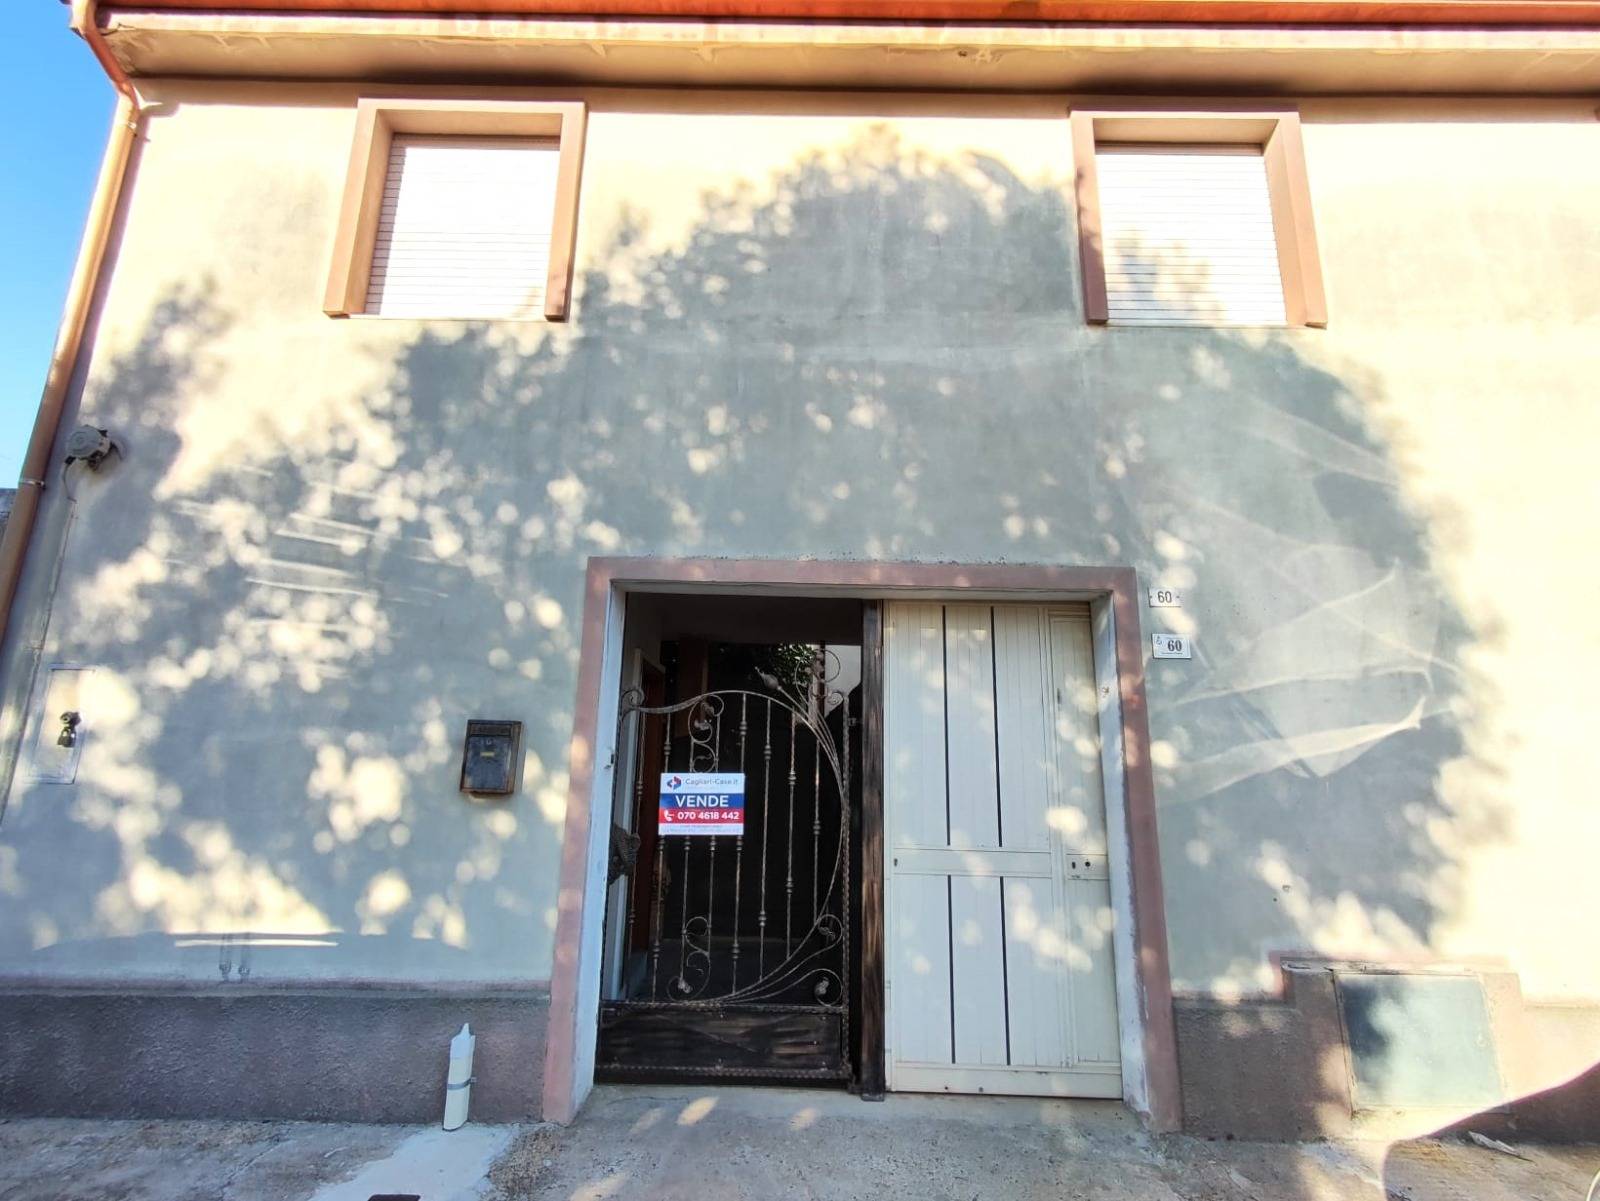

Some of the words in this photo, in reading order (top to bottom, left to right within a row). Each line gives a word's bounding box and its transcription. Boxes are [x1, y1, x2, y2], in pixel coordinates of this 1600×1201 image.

[1157, 590, 1172, 603] 60
[1167, 639, 1182, 652] 60
[675, 795, 729, 807] VENDE
[677, 811, 696, 820] 070
[698, 811, 720, 820] 4618
[721, 811, 739, 820] 442
